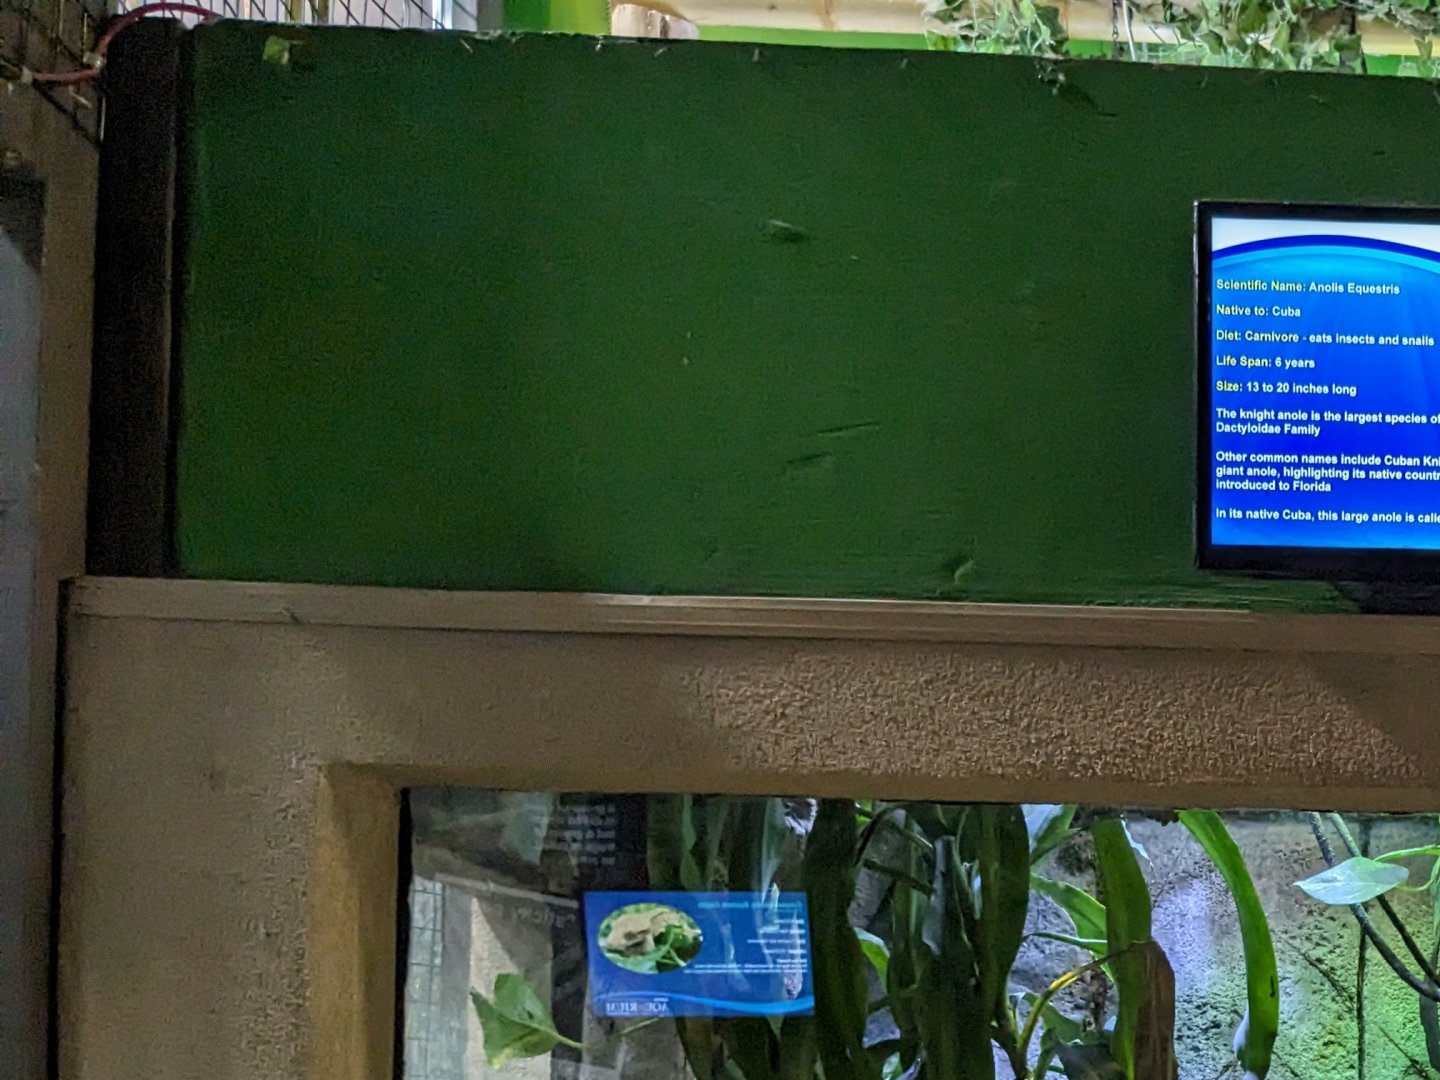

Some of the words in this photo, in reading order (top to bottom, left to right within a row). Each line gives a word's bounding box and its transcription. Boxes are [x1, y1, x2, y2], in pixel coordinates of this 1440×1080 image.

[1217, 279, 1267, 291] Scientific
[1271, 281, 1305, 292] Name:
[1309, 282, 1344, 293] Anolis
[1348, 283, 1400, 295] Equestris
[1217, 305, 1250, 316] Native
[1254, 306, 1268, 316] to:
[1273, 306, 1300, 317] Cuba
[1217, 330, 1241, 341] Diet:
[1245, 331, 1299, 343] Carnivore
[1309, 334, 1332, 344] eats
[1336, 333, 1375, 345] insects
[1379, 335, 1399, 345] and
[1402, 336, 1434, 346] snails
[1217, 356, 1236, 367] Life
[1240, 356, 1271, 368] Span:
[1275, 357, 1281, 368] 6
[1285, 360, 1315, 370] years
[1217, 381, 1242, 392] Size:
[1247, 382, 1259, 393] 13
[1262, 383, 1273, 393] to
[1277, 383, 1289, 393] 20
[1293, 383, 1329, 394] inches
[1333, 384, 1356, 396] long
[1216, 408, 1236, 419] The
[1240, 409, 1275, 421] knight
[1278, 410, 1308, 421] anole
[1311, 411, 1320, 421] is
[1324, 411, 1341, 422] the
[1345, 412, 1382, 424] largest
[1385, 413, 1427, 425] species
[1216, 422, 1281, 435] Dactyloidae
[1285, 424, 1320, 437] Family
[1216, 451, 1247, 462] Other
[1250, 454, 1298, 464] common
[1302, 455, 1337, 465] names
[1341, 454, 1381, 466] include
[1384, 455, 1420, 466] Cuban
[1216, 465, 1243, 479] giant
[1247, 466, 1280, 478] anole,
[1284, 467, 1349, 481] highlighting
[1353, 468, 1365, 479] its
[1369, 469, 1402, 480] native
[1216, 480, 1275, 490] introduced
[1279, 481, 1290, 491] to
[1293, 481, 1331, 492] Florida
[1216, 508, 1226, 518] In
[1230, 509, 1242, 519] its
[1246, 509, 1279, 520] native
[1283, 510, 1314, 522] Cuba,
[1318, 511, 1338, 521] this
[1342, 511, 1369, 523] large
[1372, 512, 1402, 523] anole
[1405, 513, 1414, 523] is
